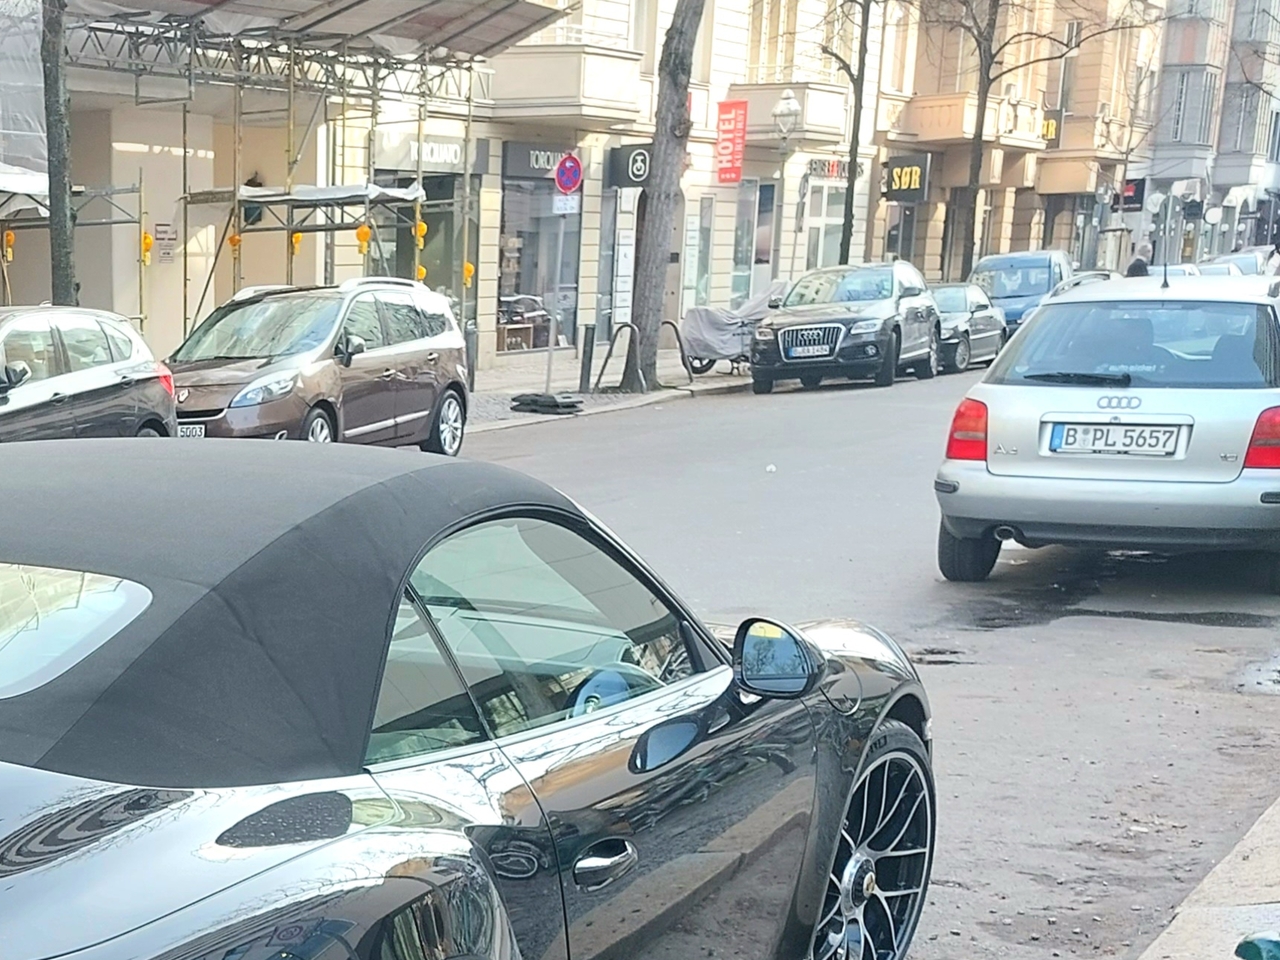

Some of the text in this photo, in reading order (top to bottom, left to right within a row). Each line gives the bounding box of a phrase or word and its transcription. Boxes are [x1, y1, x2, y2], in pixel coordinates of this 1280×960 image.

[717, 108, 736, 169] HOTEL
[891, 165, 922, 190] SØR
[180, 427, 203, 438] 5003
[1065, 428, 1078, 446] B
[1092, 428, 1117, 447] PL
[1122, 429, 1175, 449] 5657
